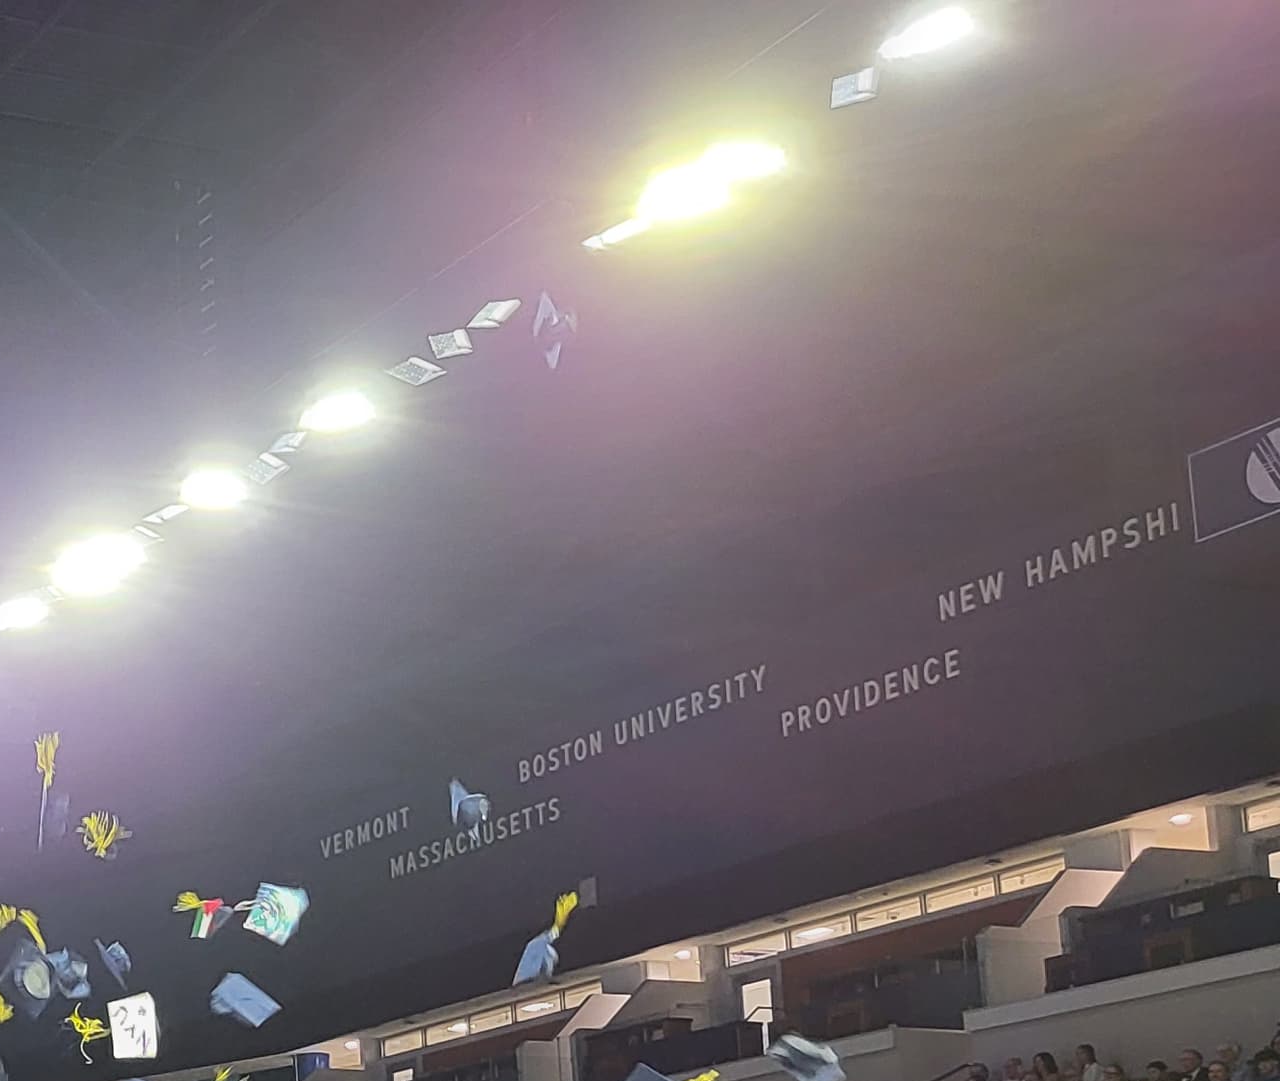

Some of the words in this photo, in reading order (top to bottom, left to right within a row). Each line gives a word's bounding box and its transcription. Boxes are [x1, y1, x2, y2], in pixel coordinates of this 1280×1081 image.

[938, 571, 1005, 622] NEW
[1025, 502, 1181, 588] HAMPSHI
[518, 731, 602, 783] BOSTON
[613, 665, 768, 746] UNIVERSITY
[780, 648, 962, 737] PROVIDENCE
[319, 806, 410, 859] VERMONT
